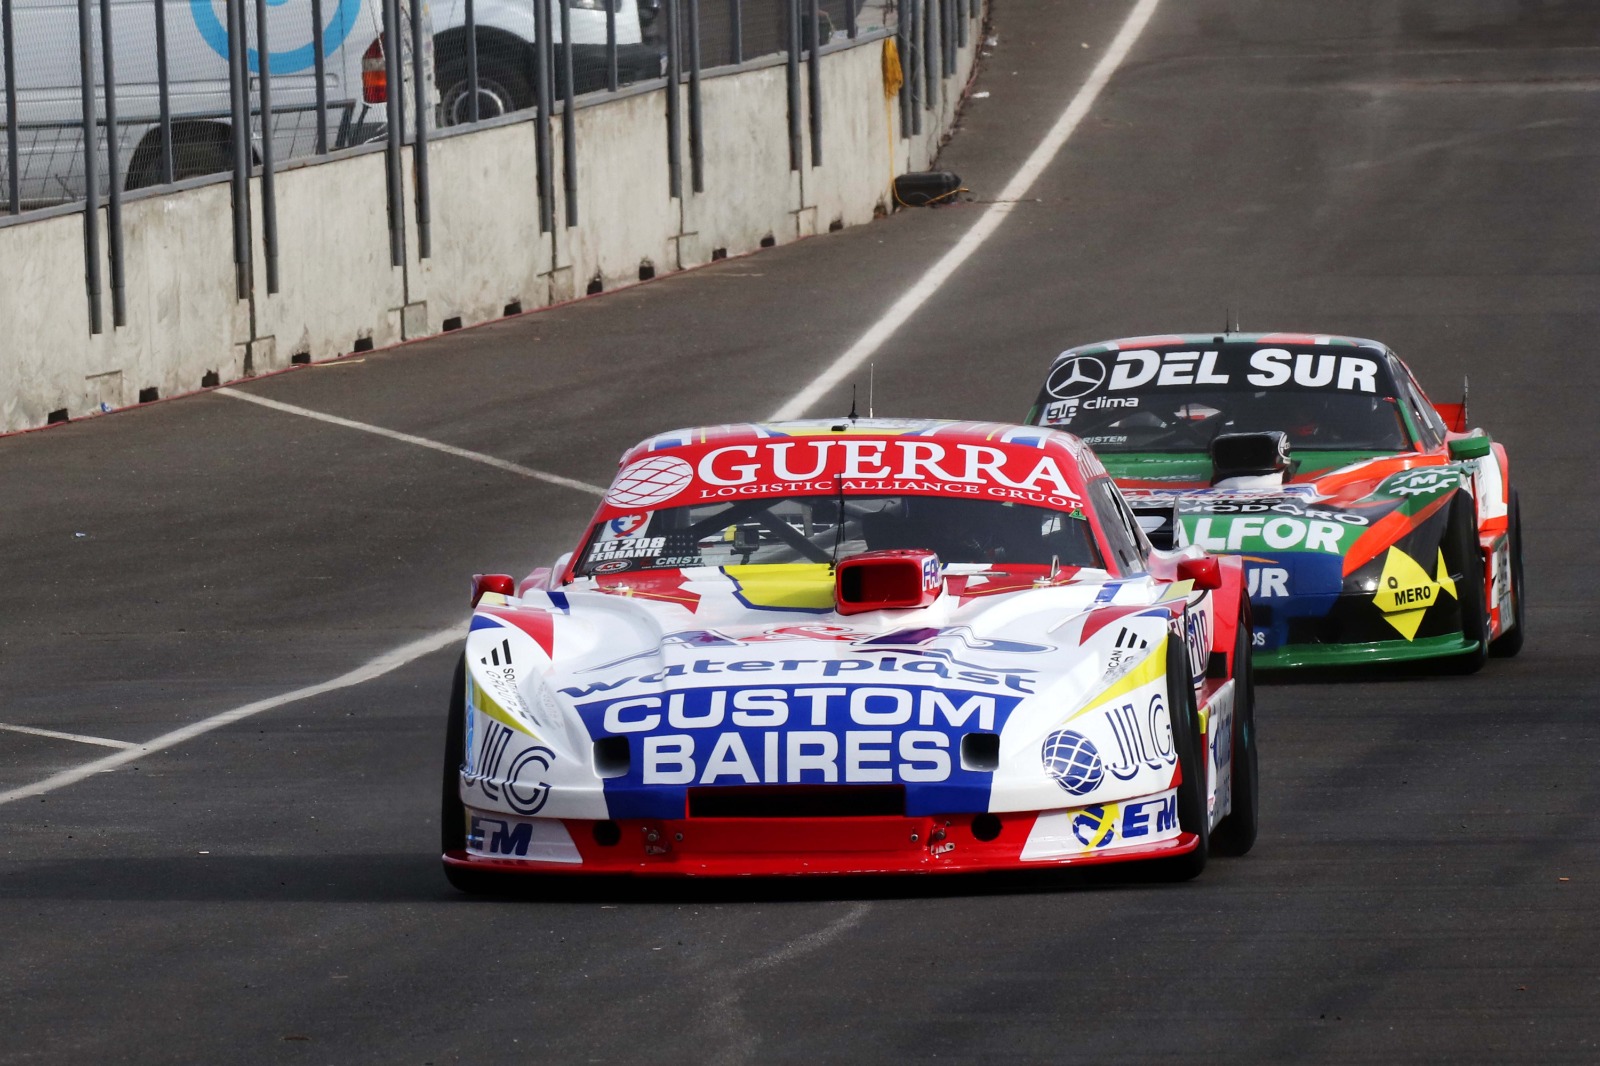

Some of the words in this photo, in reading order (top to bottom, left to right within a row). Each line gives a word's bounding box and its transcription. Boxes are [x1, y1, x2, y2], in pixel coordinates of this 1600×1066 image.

[1108, 350, 1229, 391] DEL
[1247, 347, 1378, 393] SUR
[1083, 396, 1140, 409] clima
[1083, 435, 1128, 443] RISTEM
[697, 439, 1085, 501] GUERRA
[700, 480, 832, 498] LOGISTIC
[841, 479, 981, 494] ALLIANCE
[987, 487, 1084, 509] GRUOP
[588, 548, 663, 562] FERRANTE
[593, 540, 619, 553] TC
[655, 555, 706, 566] CRIST
[1394, 585, 1432, 606] MERO
[557, 655, 1040, 699] waterplast
[603, 685, 997, 733] CUSTOM
[642, 730, 952, 786] BAIRES
[1121, 796, 1178, 839] ETM
